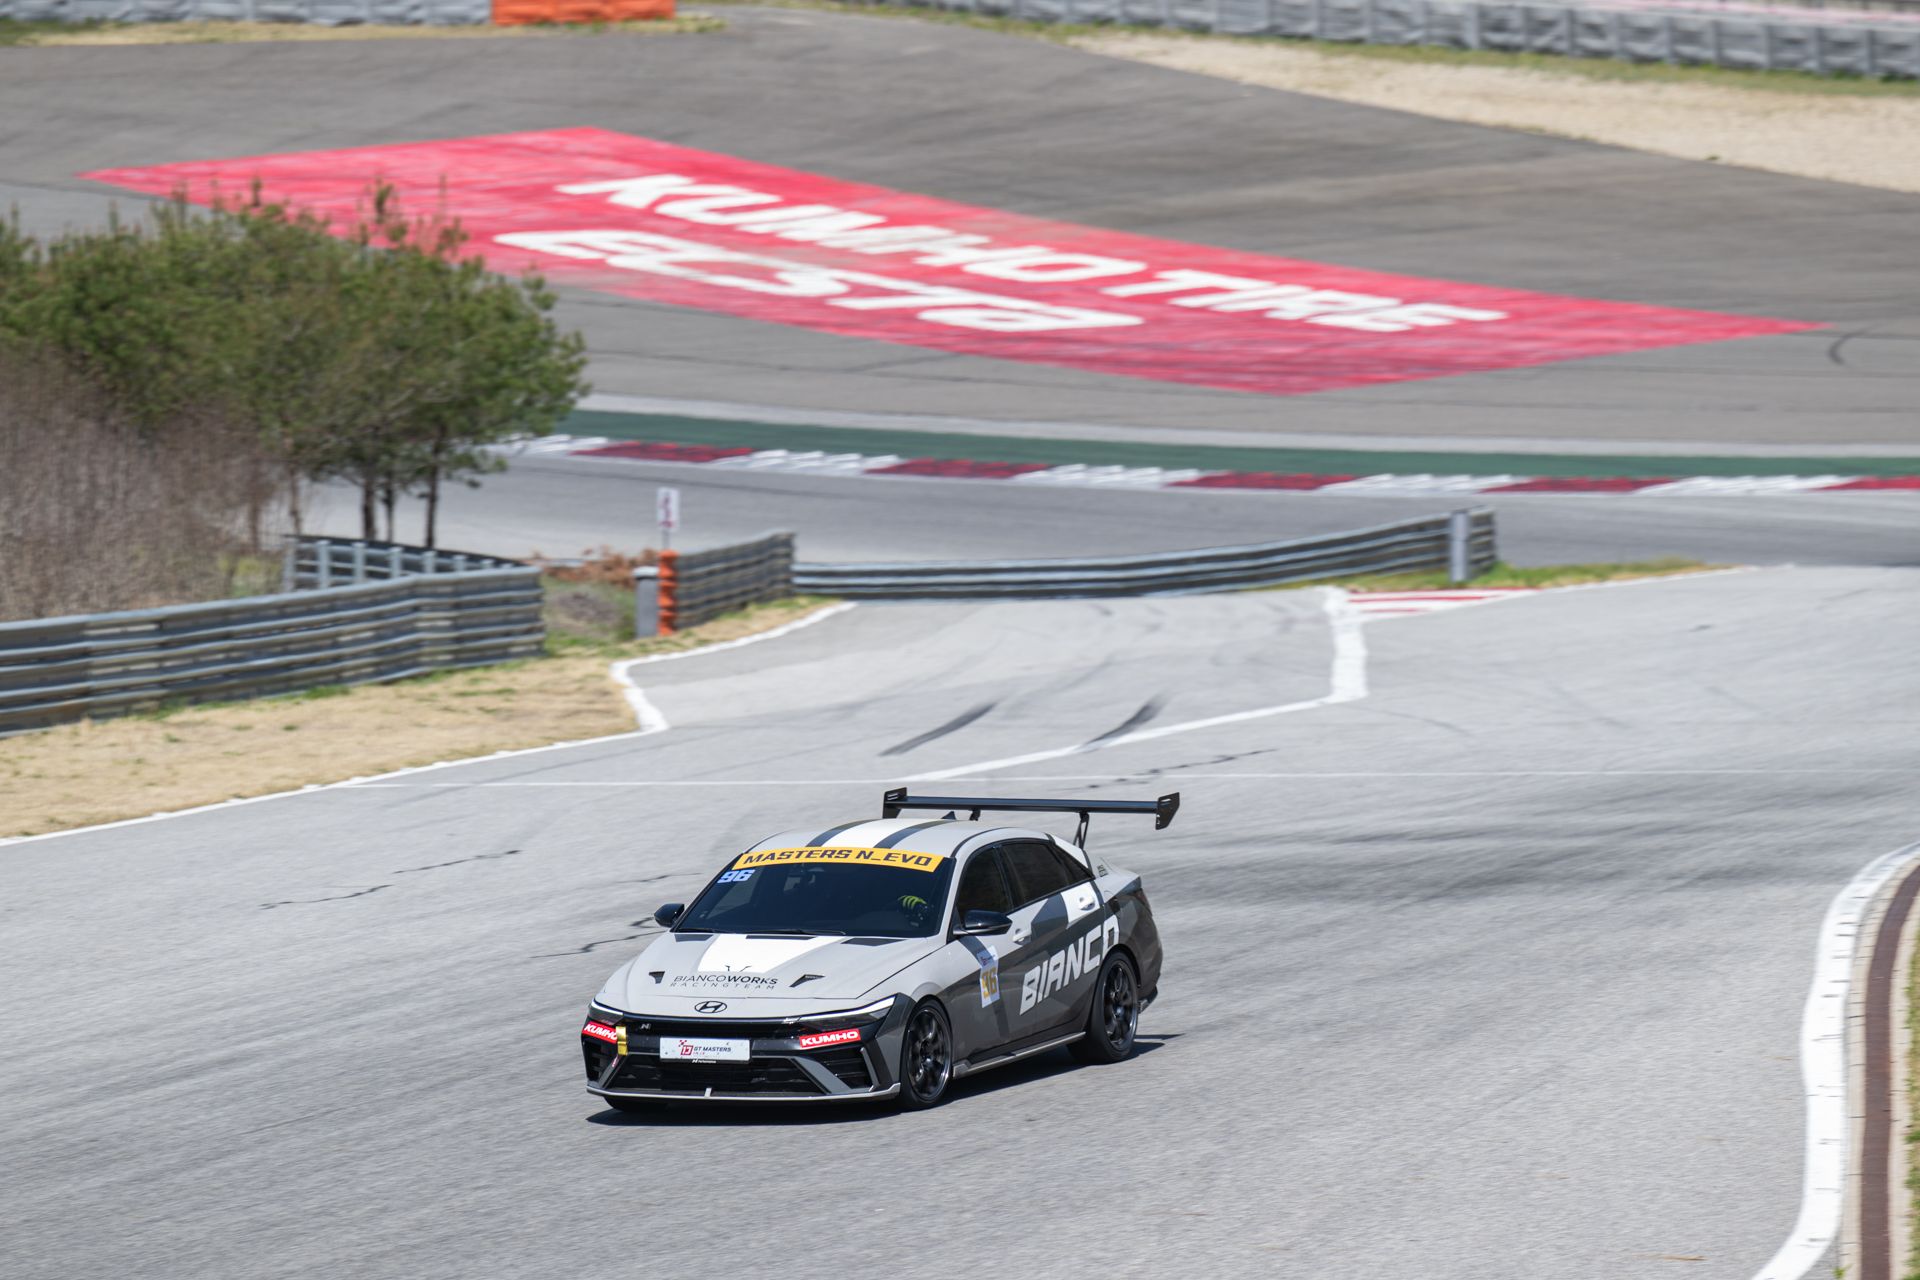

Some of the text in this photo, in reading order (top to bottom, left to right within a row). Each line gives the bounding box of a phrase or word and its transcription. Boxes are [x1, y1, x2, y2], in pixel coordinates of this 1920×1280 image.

[554, 173, 1511, 332] KUMHO TIRE
[742, 849, 851, 865] MASTERS
[717, 869, 755, 884] 96
[1019, 914, 1120, 1016] BIANCO
[584, 1023, 618, 1042] KUMHO
[801, 1031, 859, 1047] KUMHO
